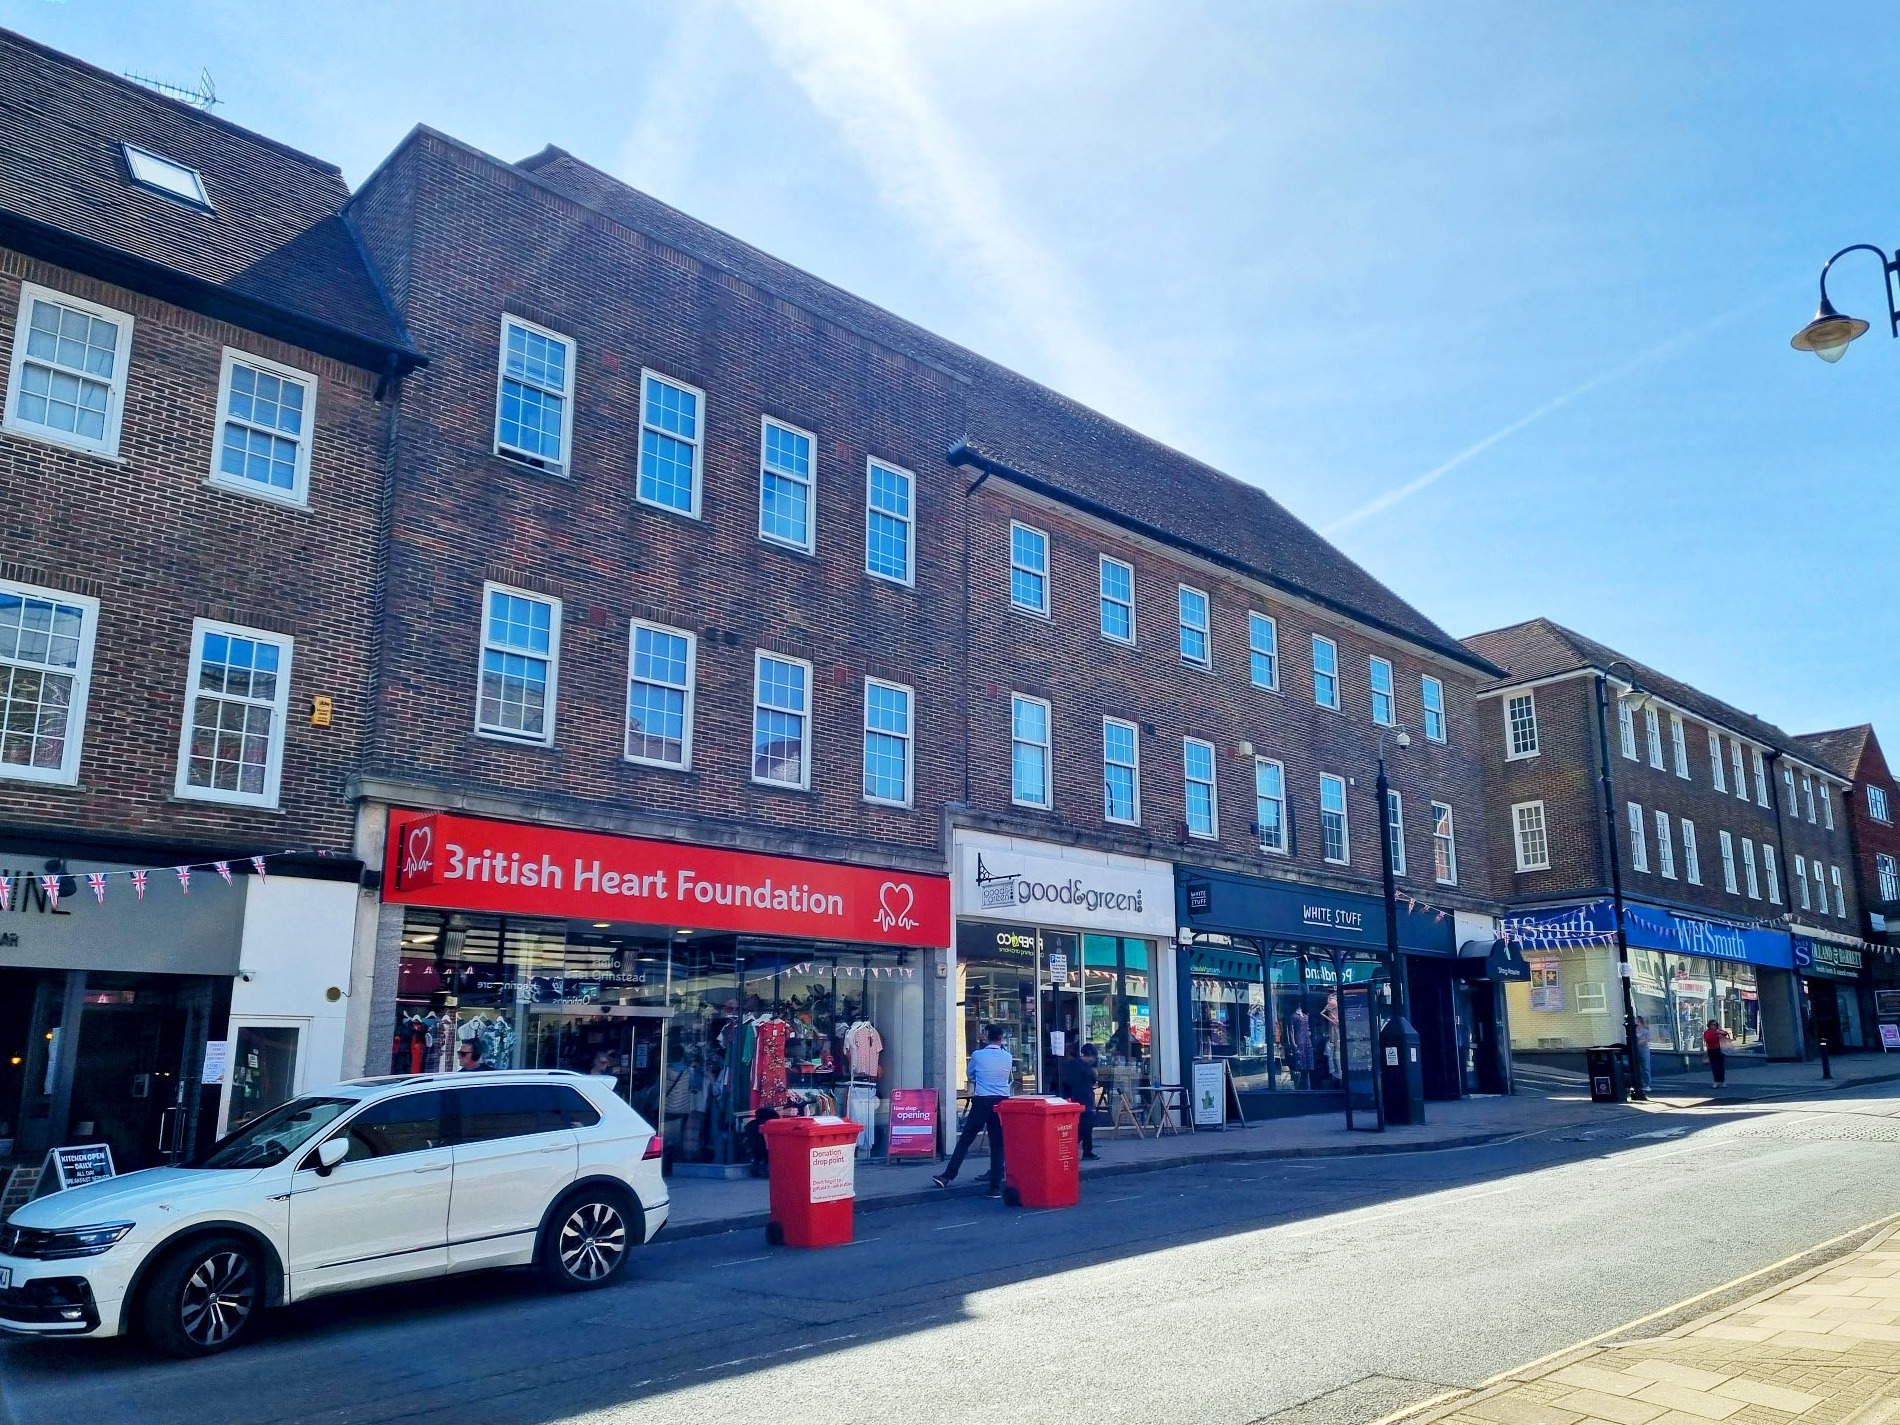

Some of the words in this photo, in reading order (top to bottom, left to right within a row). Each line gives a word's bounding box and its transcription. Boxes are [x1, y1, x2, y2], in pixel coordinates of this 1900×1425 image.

[444, 844, 562, 889] British
[574, 858, 668, 898] Heart
[677, 870, 844, 916] Foundation
[1018, 878, 1138, 912] good&green
[1303, 904, 1332, 922] WHITE
[1335, 909, 1362, 926] STUFF
[1674, 918, 1747, 959] WHSmith
[897, 1111, 930, 1120] opening
[812, 1149, 842, 1157] Donation
[829, 1157, 844, 1166] point
